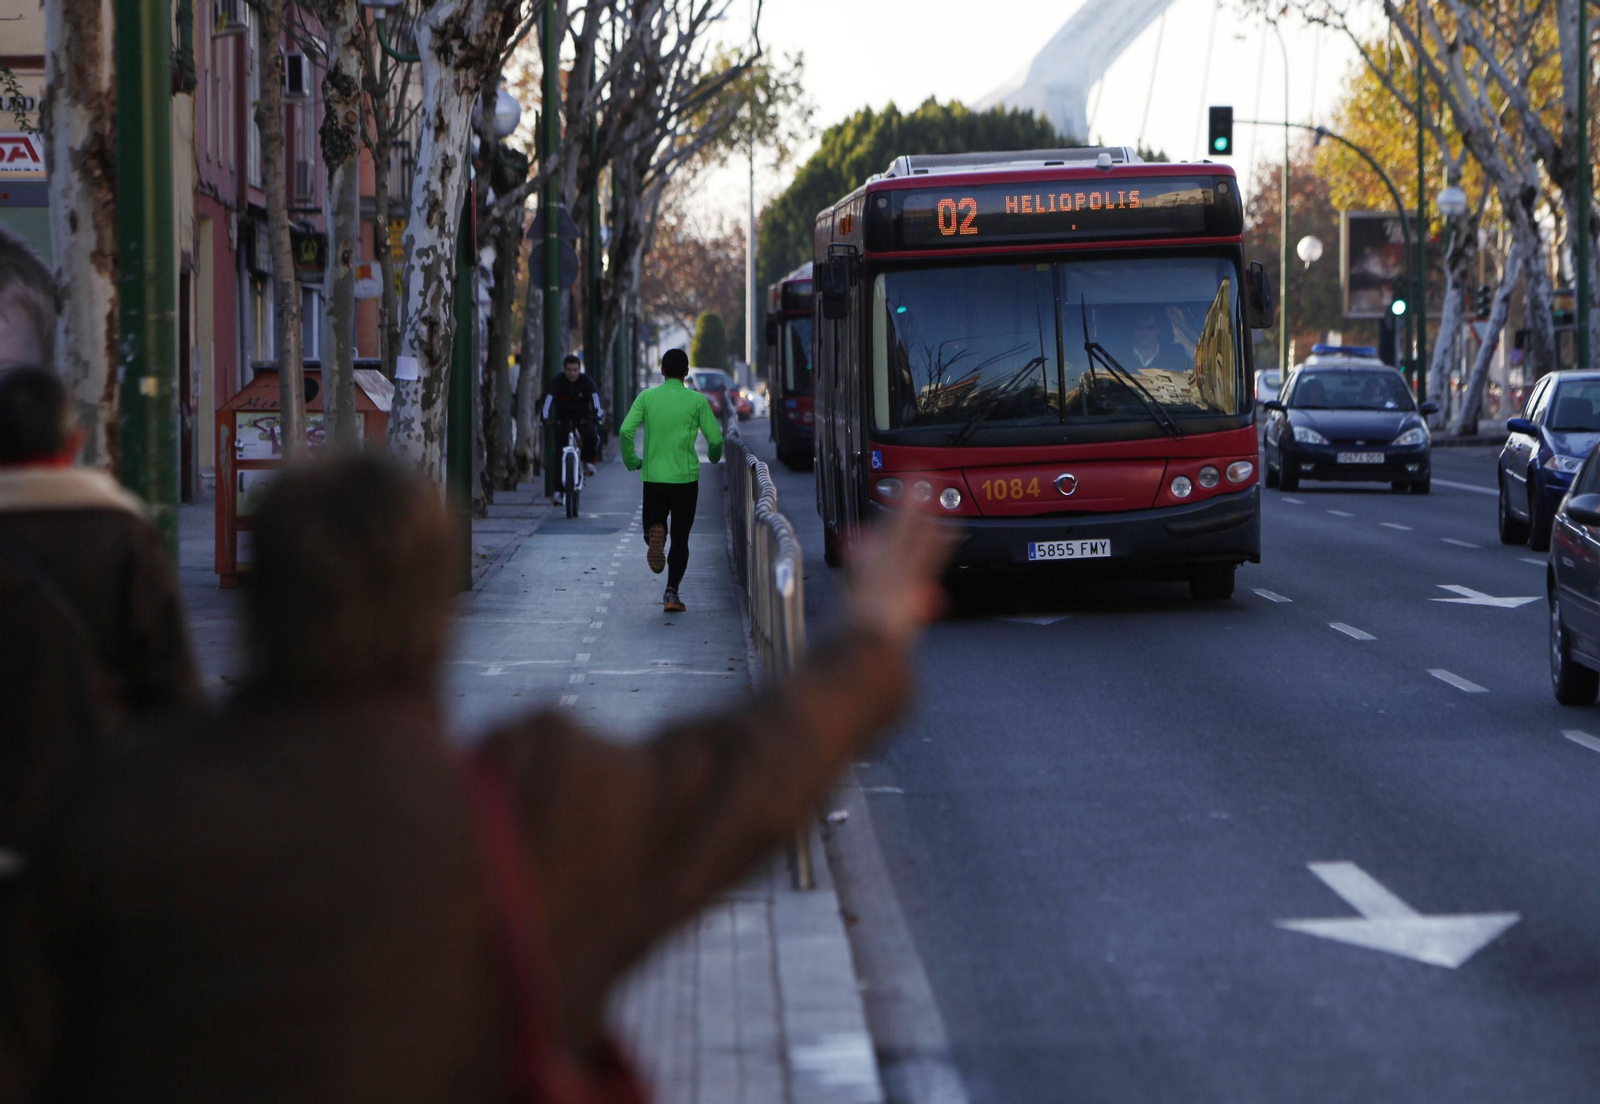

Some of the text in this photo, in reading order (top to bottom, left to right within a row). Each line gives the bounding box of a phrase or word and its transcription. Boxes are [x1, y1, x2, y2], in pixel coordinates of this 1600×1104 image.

[937, 190, 1140, 236] 02 HELIOPOLIS
[981, 477, 1041, 500] 1084
[1037, 541, 1108, 558] 5855 FMY
